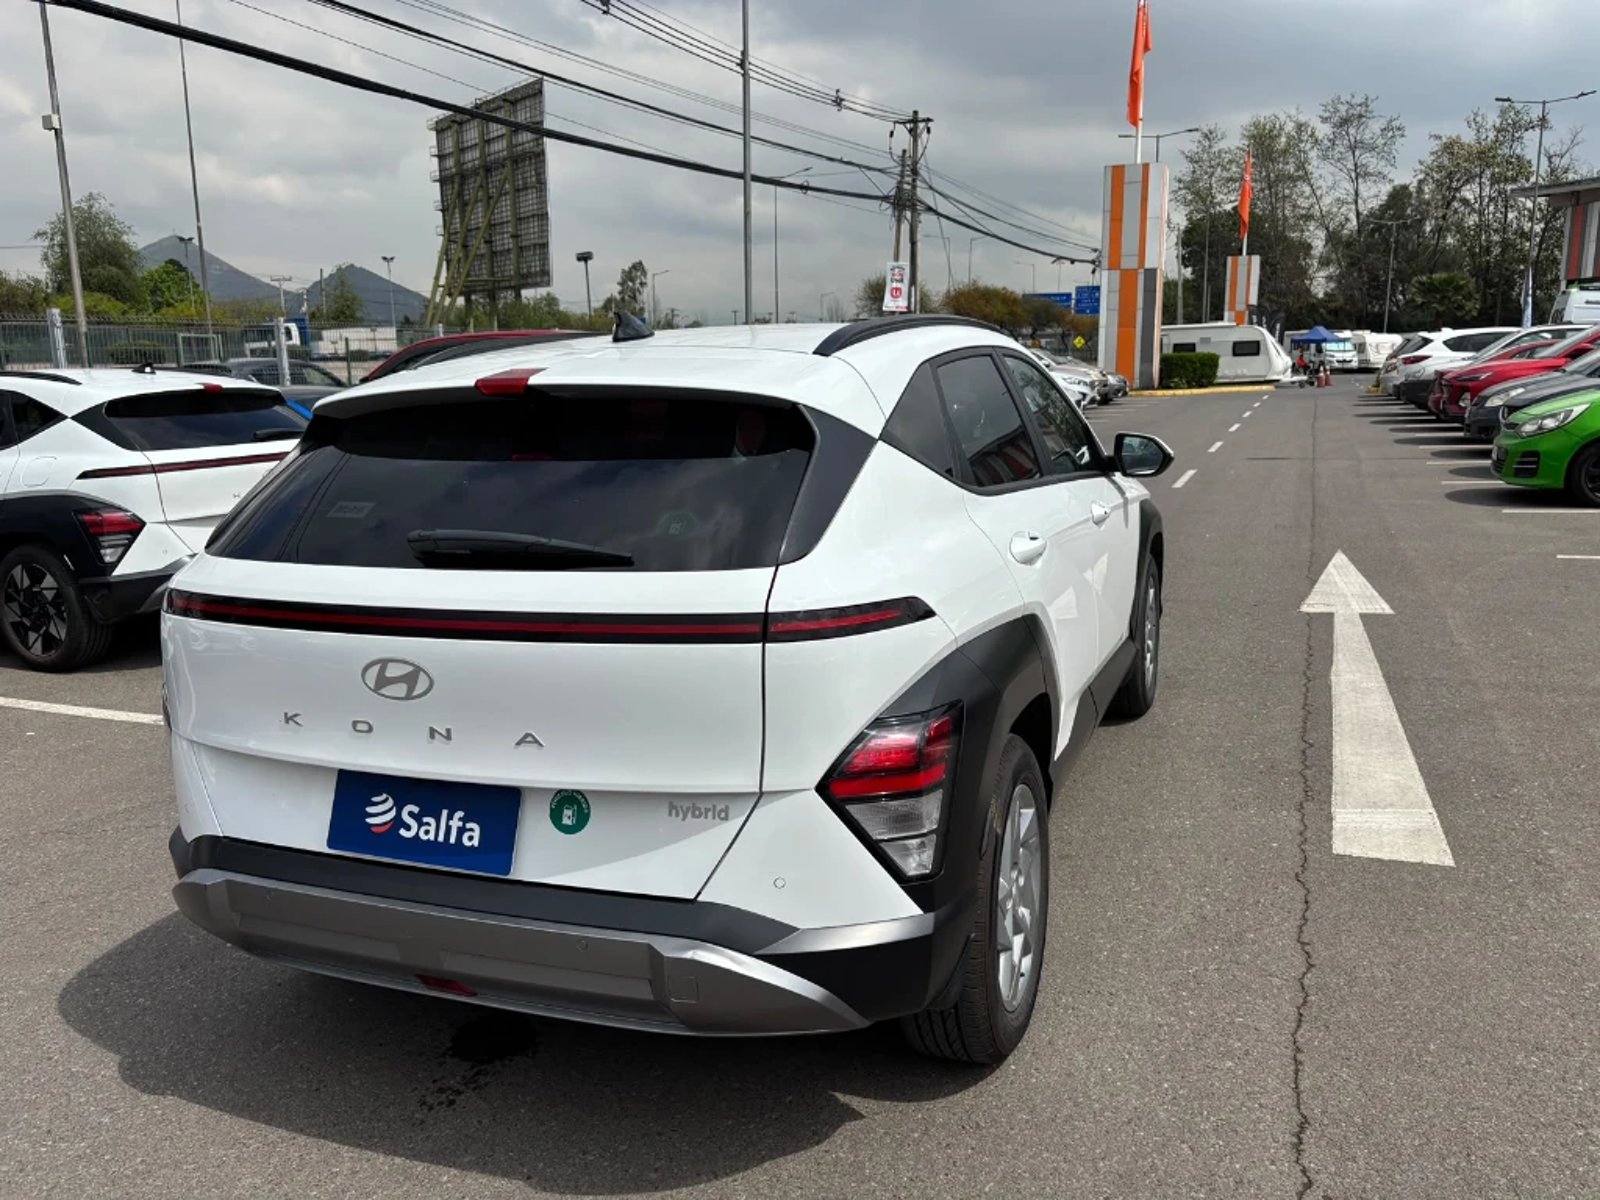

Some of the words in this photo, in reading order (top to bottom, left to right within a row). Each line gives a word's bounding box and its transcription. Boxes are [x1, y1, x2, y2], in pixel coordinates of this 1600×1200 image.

[283, 711, 545, 748] KONA
[398, 803, 481, 848] Salfa
[667, 800, 730, 821] hybrid
